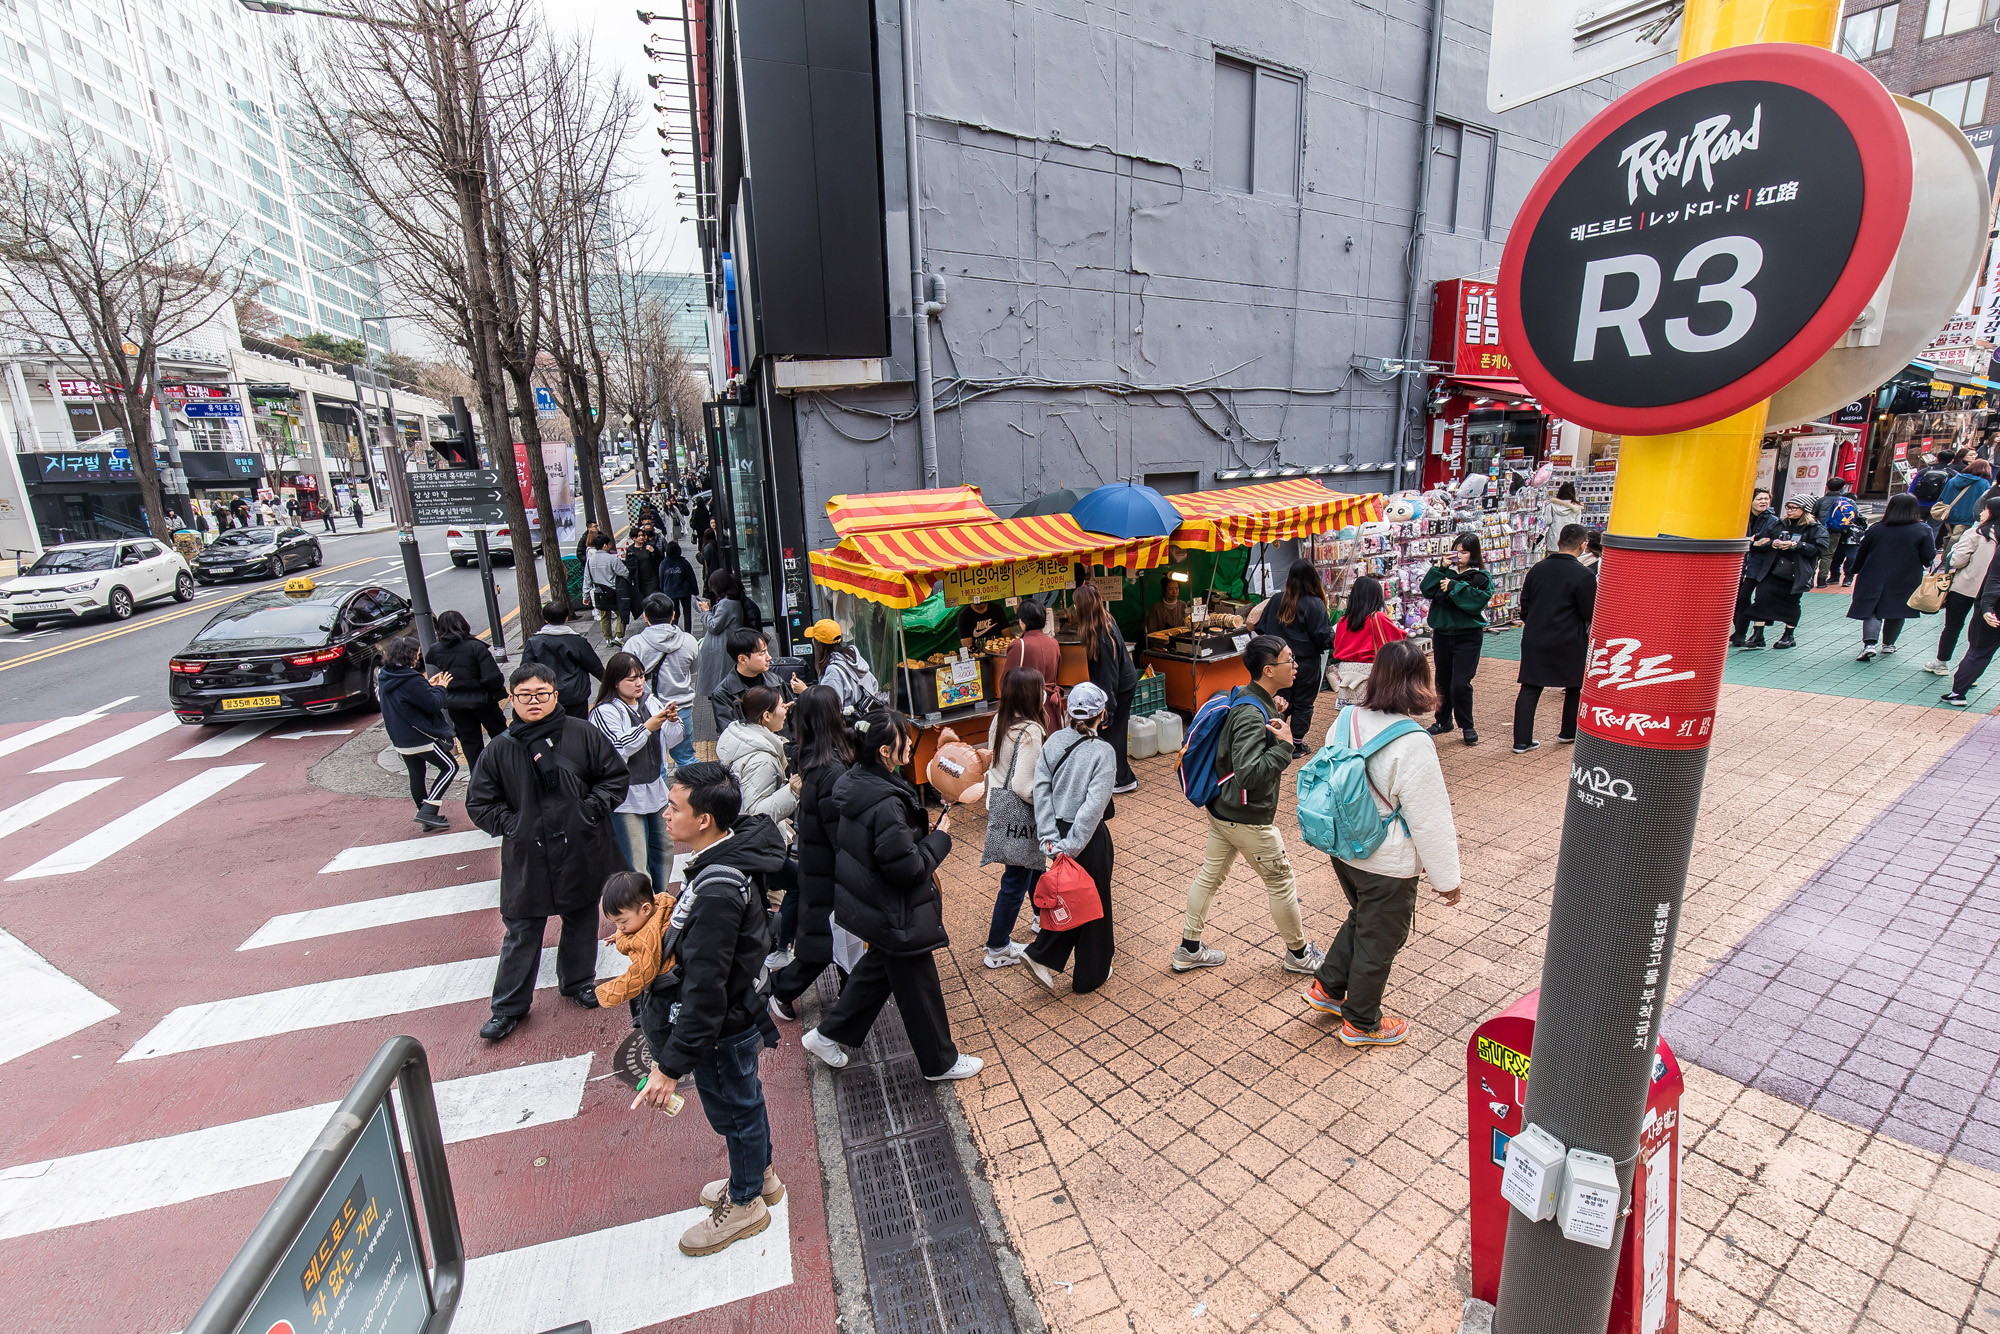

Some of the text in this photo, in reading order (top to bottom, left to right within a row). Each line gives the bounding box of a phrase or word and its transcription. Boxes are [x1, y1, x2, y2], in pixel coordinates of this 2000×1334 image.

[1570, 215, 1633, 241] 레드로드
[1756, 181, 1800, 206] 红路
[1573, 235, 1764, 362] R3
[44, 453, 102, 474] 지구별
[412, 472, 447, 481] 관광경찰대
[449, 472, 477, 480] 홍대센터
[418, 507, 472, 516] 서교예술실험센터
[950, 565, 1011, 587] 미니잉어빵
[1015, 561, 1037, 578] 맛있는
[1040, 575, 1065, 587] 2,000원
[976, 618, 992, 629] NIKE
[252, 697, 277, 706] 4385
[1570, 763, 1637, 801] MAPO
[1577, 790, 1605, 808] 마포구
[304, 1199, 357, 1292] 레드로드
[312, 1290, 327, 1325] 차
[329, 1248, 354, 1299] 없는
[355, 1197, 379, 1245] 거리
